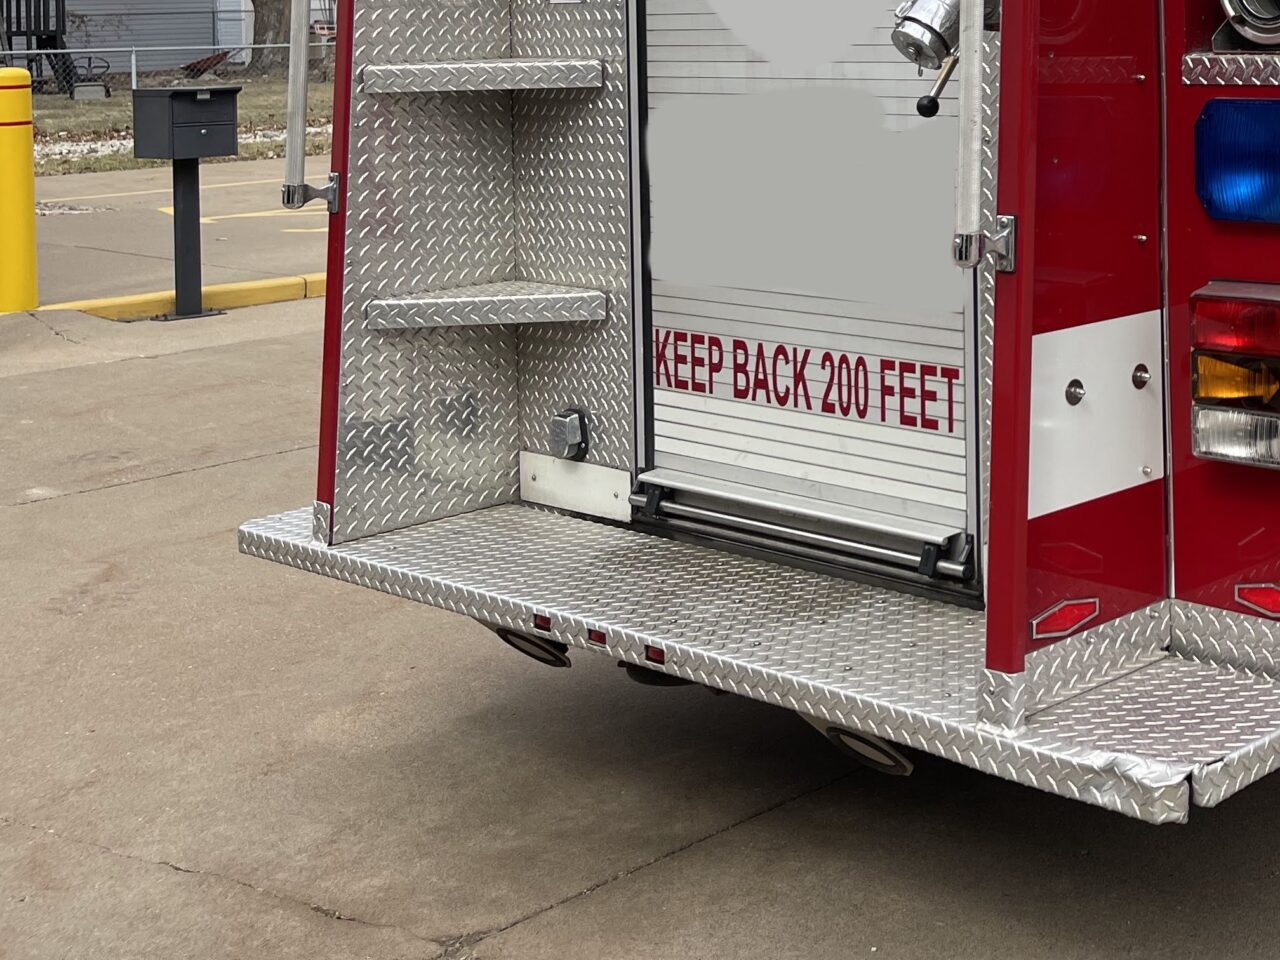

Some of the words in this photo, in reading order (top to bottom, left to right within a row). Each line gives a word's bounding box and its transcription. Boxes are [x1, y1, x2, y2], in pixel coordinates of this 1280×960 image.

[655, 328, 724, 394] KEEP
[732, 339, 812, 411] BACK
[820, 351, 869, 420] 200
[880, 358, 960, 433] FEET
